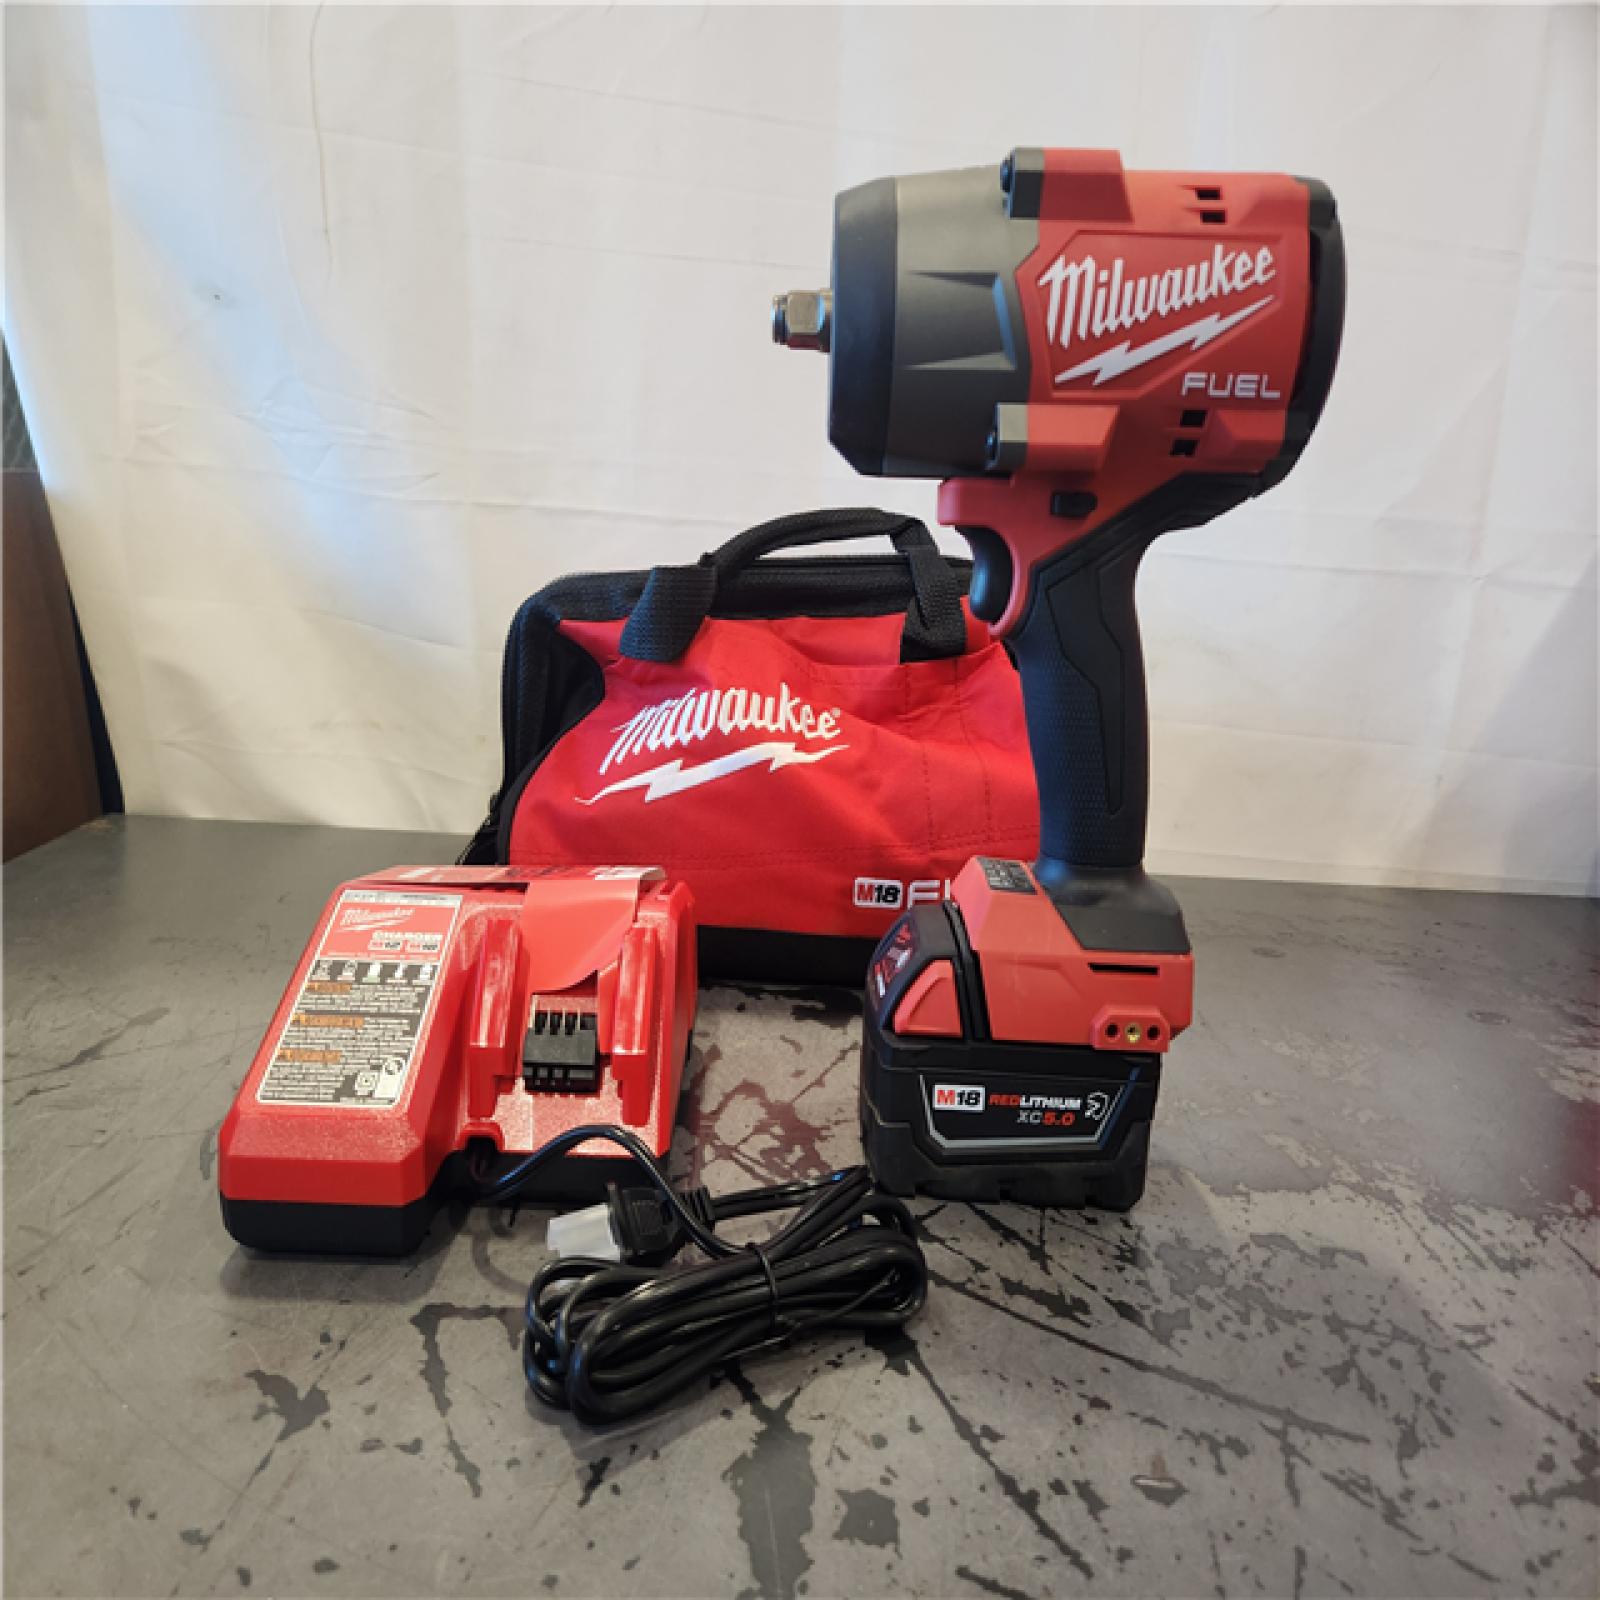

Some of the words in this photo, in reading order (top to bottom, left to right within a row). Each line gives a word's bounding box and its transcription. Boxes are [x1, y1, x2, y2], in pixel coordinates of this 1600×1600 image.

[1038, 243, 1276, 349] Milwaukee
[1182, 371, 1281, 398] FUEL
[856, 882, 901, 905] M18
[936, 1087, 983, 1108] M18
